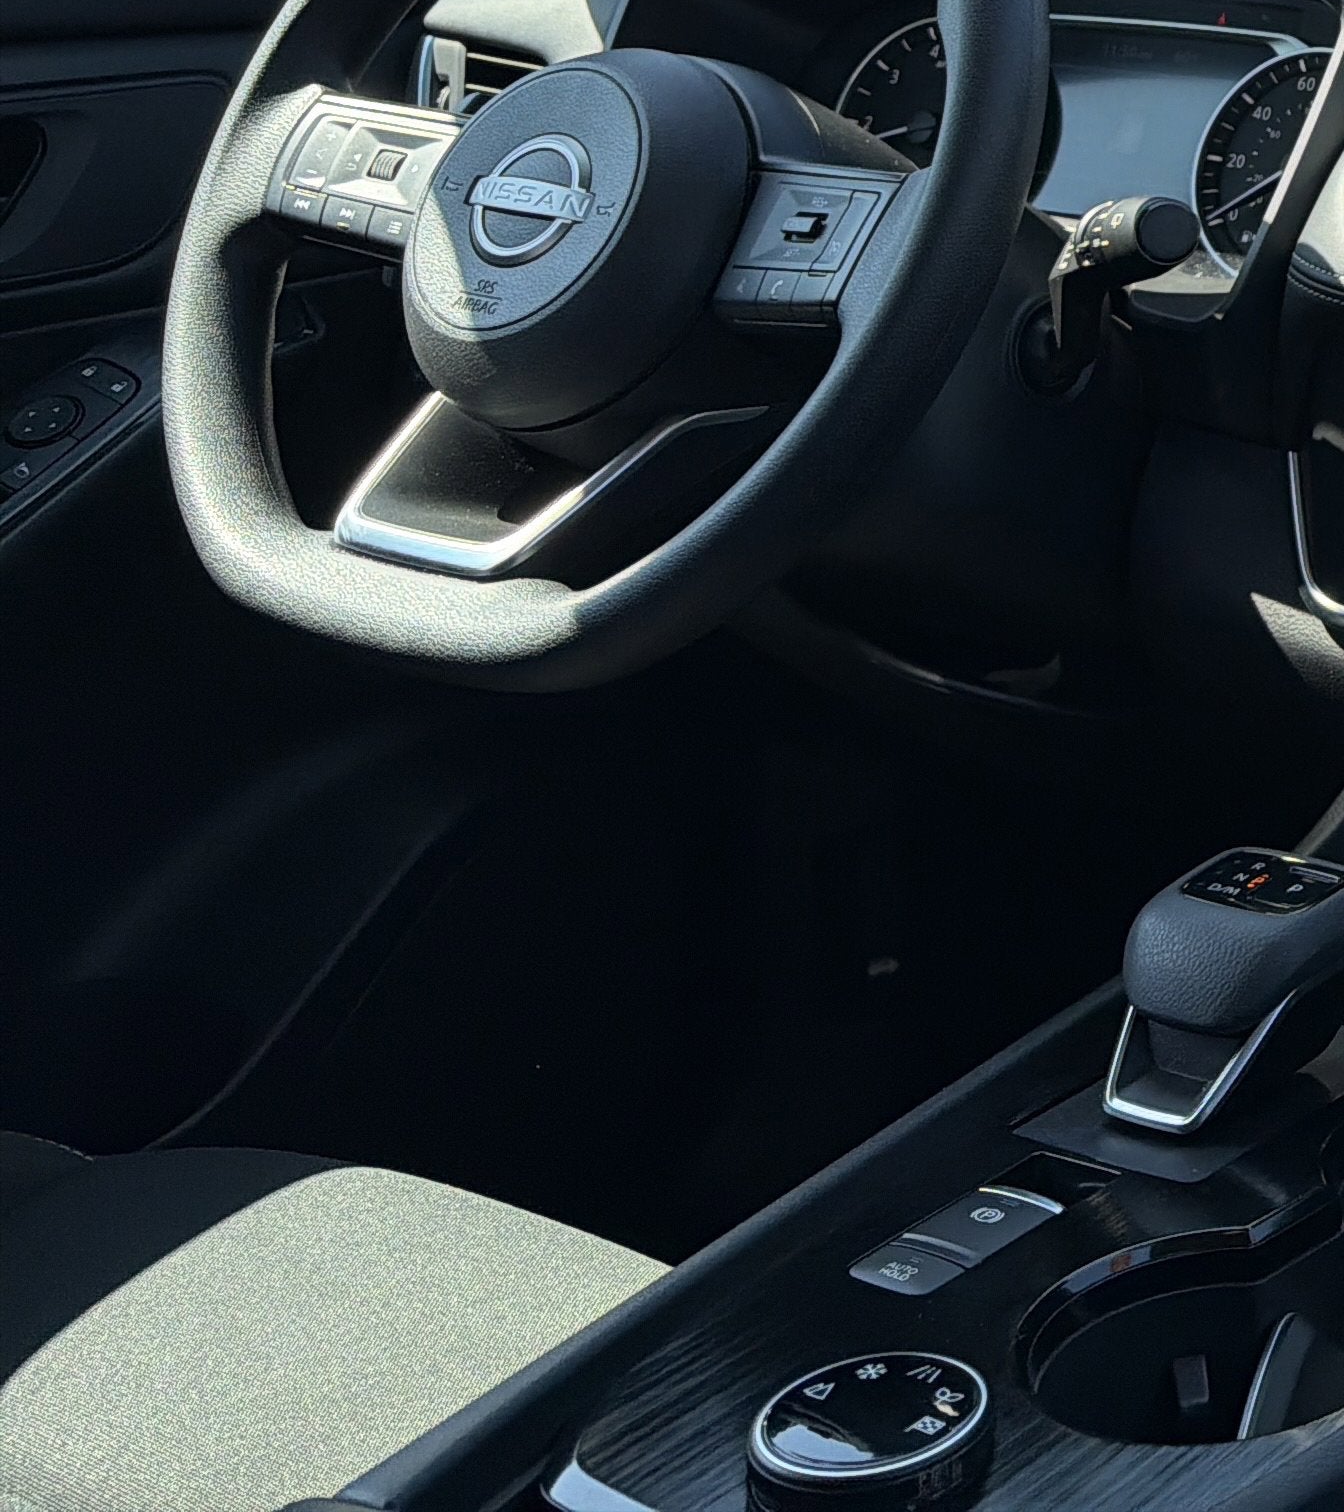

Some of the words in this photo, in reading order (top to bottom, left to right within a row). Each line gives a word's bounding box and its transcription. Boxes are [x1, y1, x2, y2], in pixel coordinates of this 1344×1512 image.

[929, 44, 940, 58] 4
[889, 69, 900, 85] 3
[1297, 76, 1316, 92] 60
[1252, 106, 1272, 121] 40
[1226, 153, 1245, 169] 20
[475, 180, 591, 218] NISSAN
[474, 279, 498, 294] SRS
[453, 296, 499, 316] AIRBAG
[1251, 862, 1266, 870] R
[1232, 872, 1250, 882] N
[1286, 883, 1304, 893] P
[878, 1268, 910, 1282] HOLD
[885, 1261, 919, 1275] AUTO
